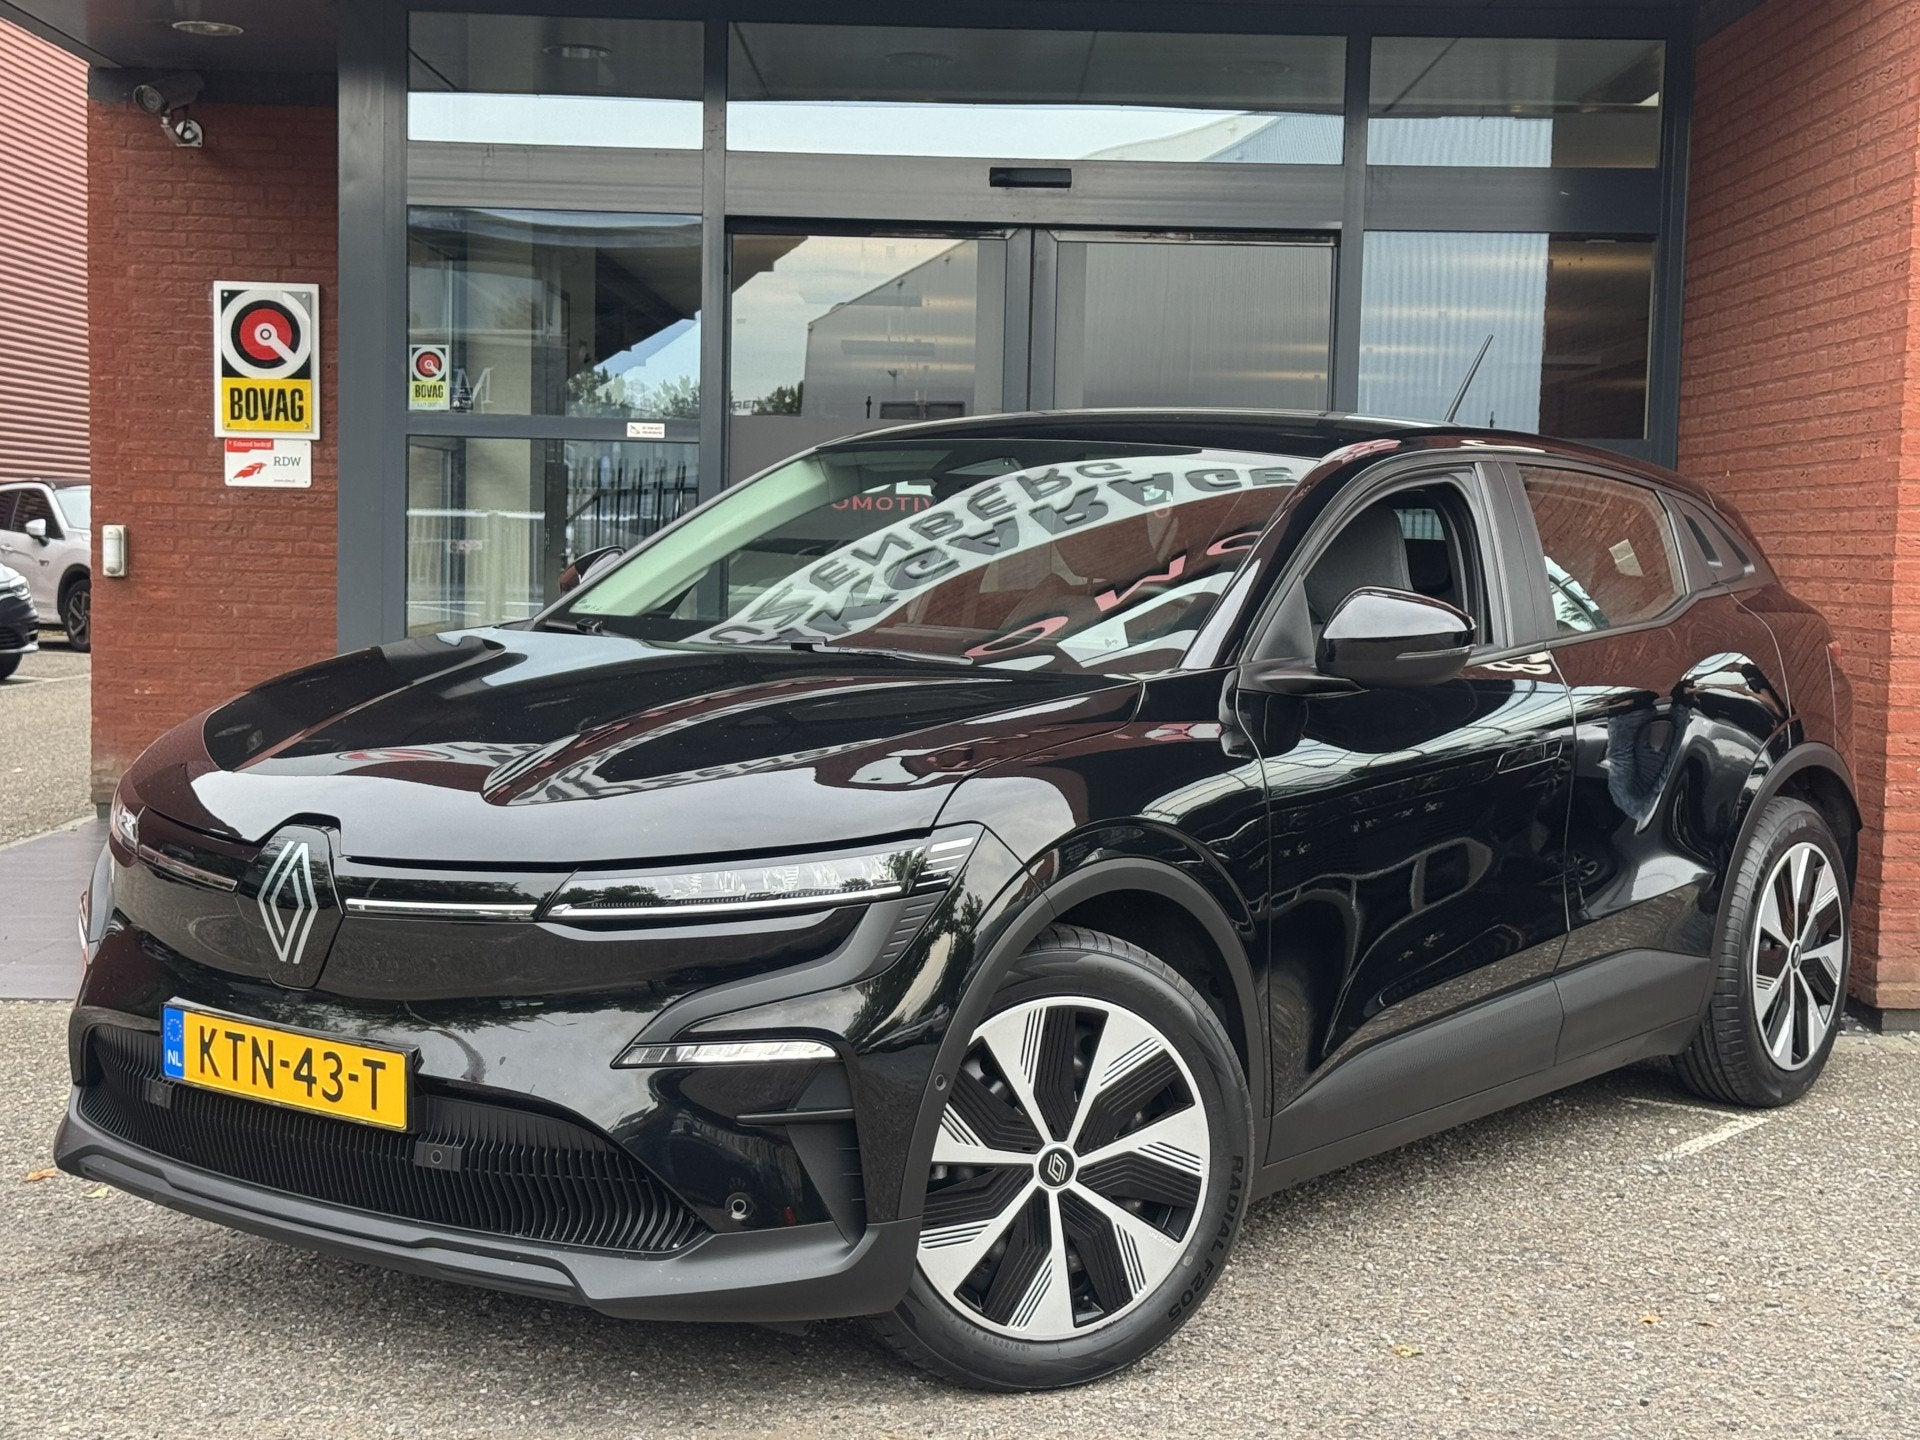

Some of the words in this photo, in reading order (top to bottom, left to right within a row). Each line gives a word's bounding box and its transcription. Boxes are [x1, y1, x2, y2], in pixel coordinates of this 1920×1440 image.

[229, 387, 304, 422] BOVAG
[415, 384, 444, 399] BOVAG
[273, 456, 302, 467] RDW
[167, 1049, 183, 1067] NL
[199, 1025, 387, 1111] KTN-43-T
[1211, 1155, 1244, 1252] RADIAL
